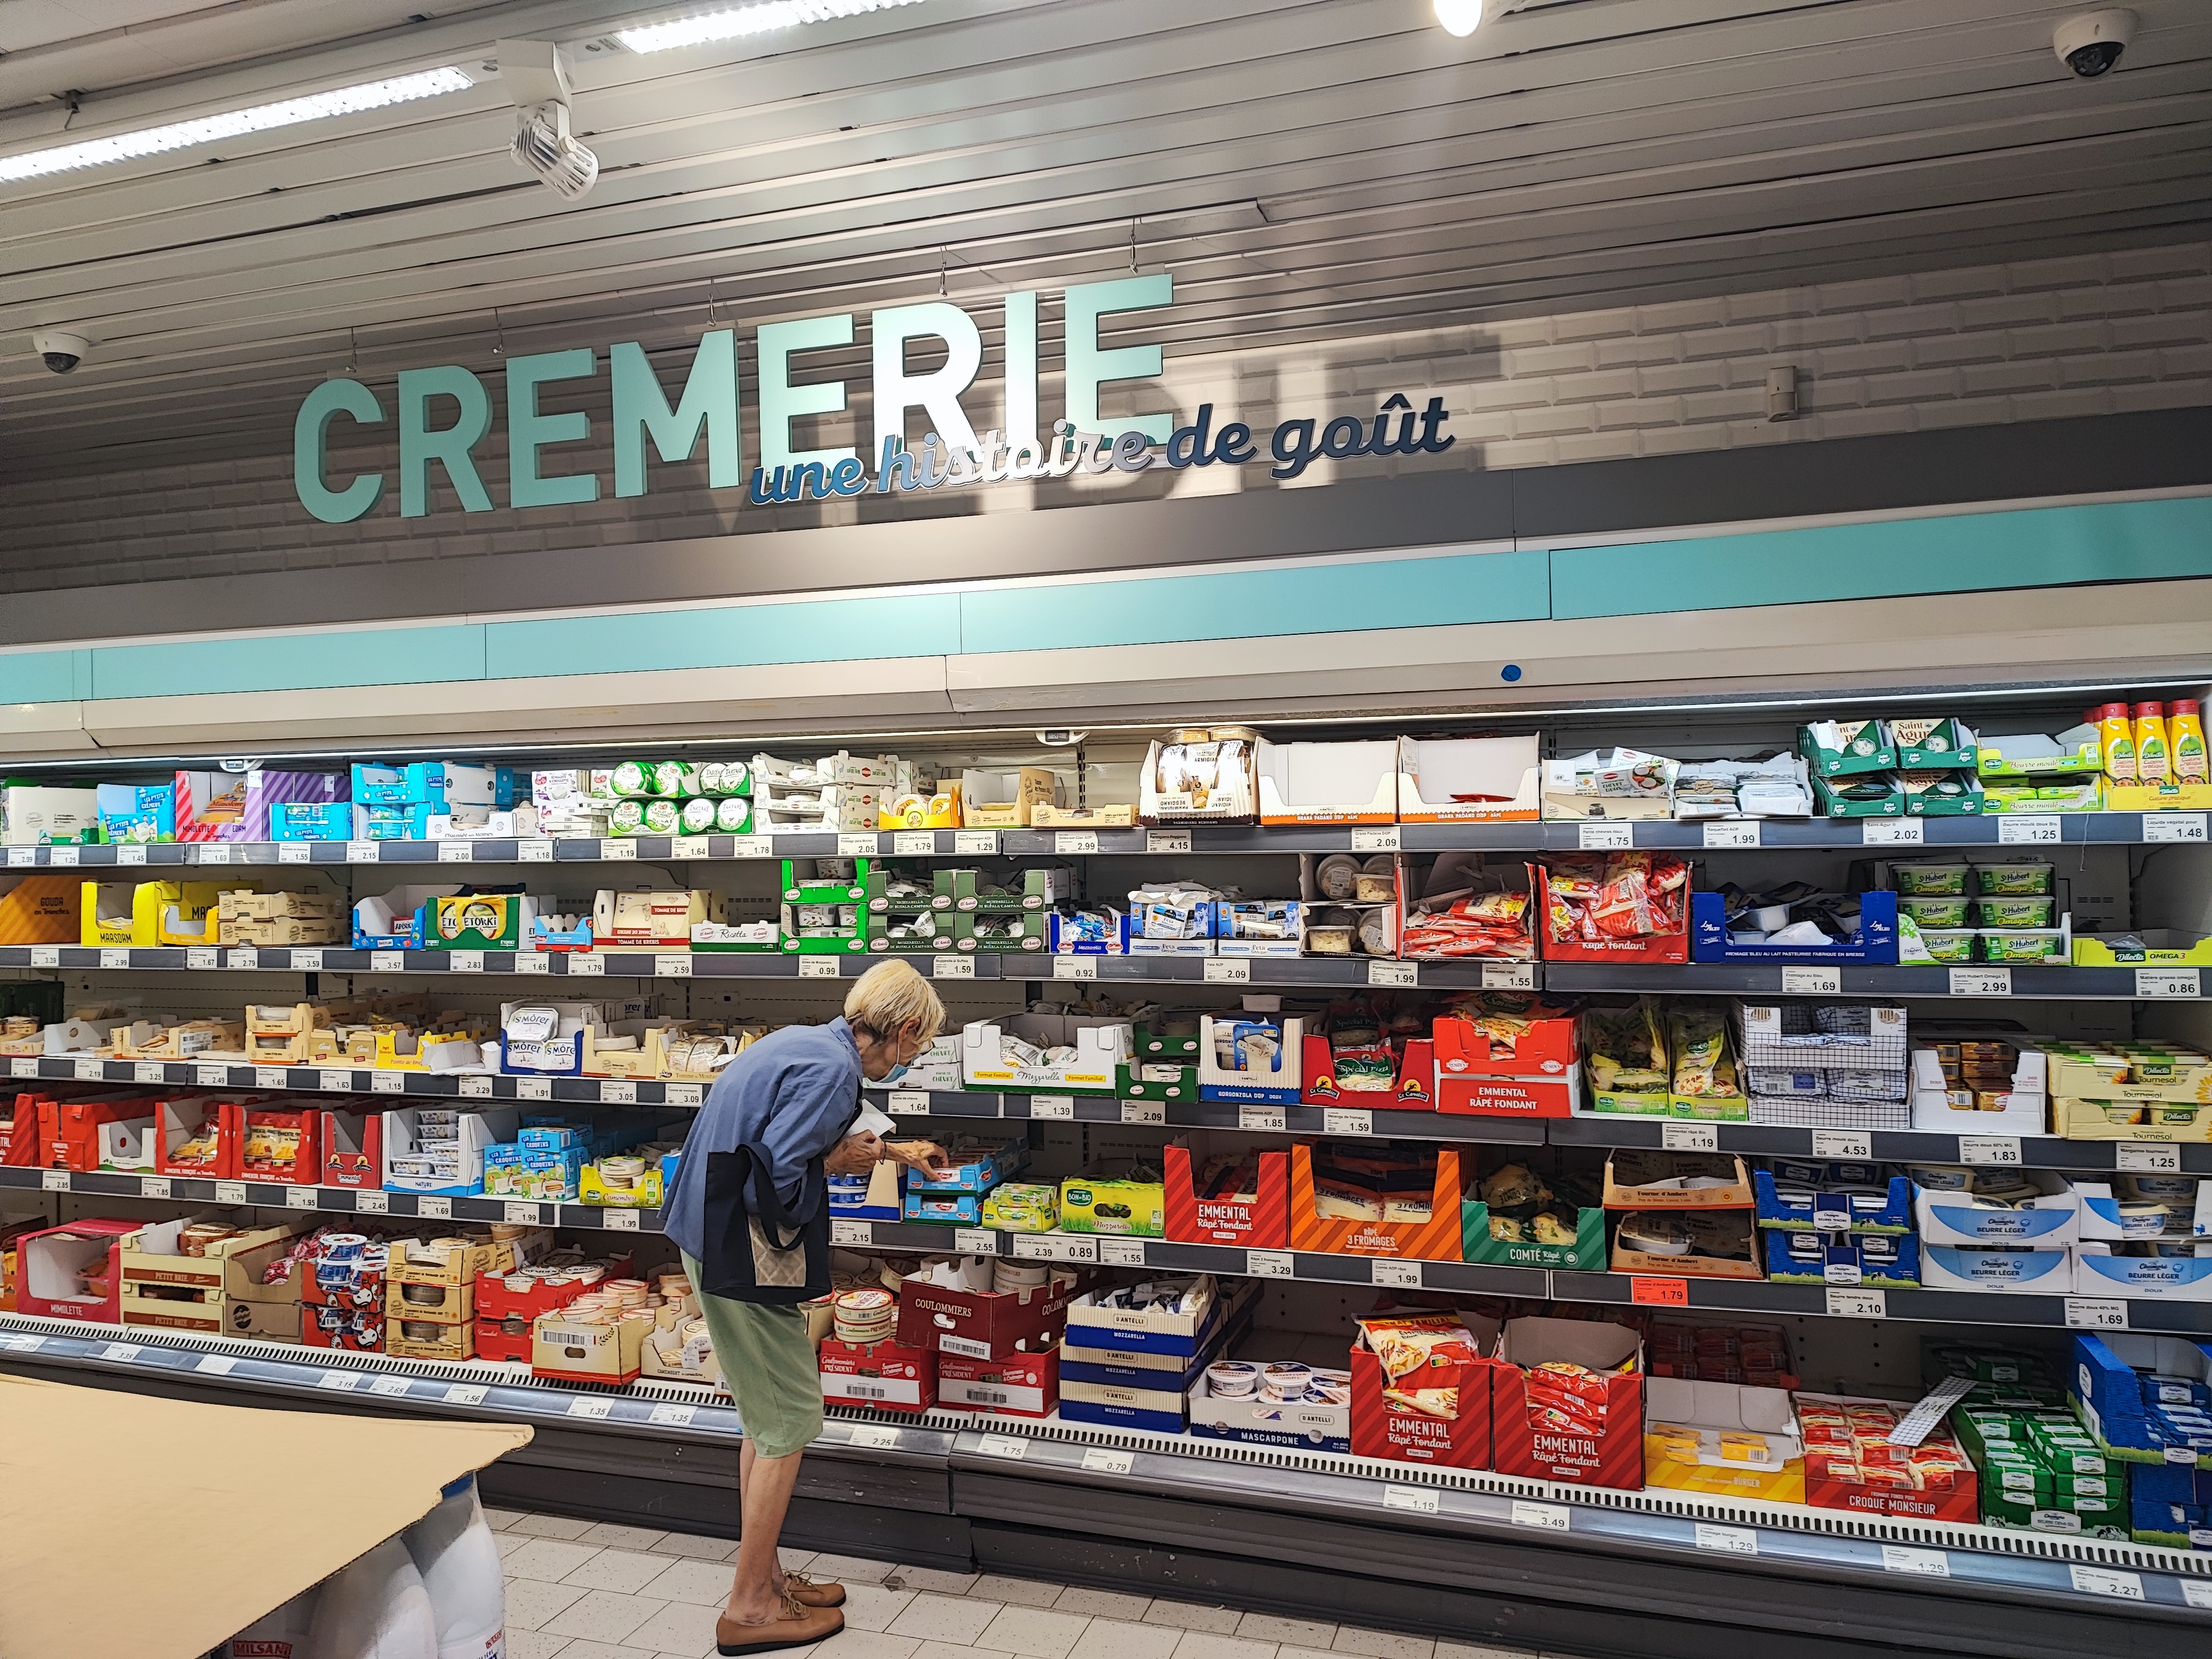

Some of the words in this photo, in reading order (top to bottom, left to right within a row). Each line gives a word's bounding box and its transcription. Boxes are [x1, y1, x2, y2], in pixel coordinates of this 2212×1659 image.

[294, 274, 1174, 524] CREMERIE
[749, 452, 870, 507] une
[878, 420, 1155, 492] histoire
[1164, 405, 1255, 469] de
[1269, 392, 1456, 479] goût
[1898, 722, 1923, 730] Saint
[1896, 731, 1931, 745] Agur
[2010, 760, 2036, 769] Beurre
[2038, 759, 2058, 768] moulé
[2010, 801, 2036, 810] Beurre
[1894, 831, 1918, 839] 2.02
[2032, 831, 2056, 839] 1.25
[2177, 829, 2201, 837] 1.48
[1377, 839, 1396, 847] 2.09
[1733, 835, 1755, 843] 1.99
[41, 897, 63, 906] GOUDA
[101, 933, 132, 943] MAASDAM
[720, 928, 748, 939] Ricotta
[2017, 939, 2038, 948] Hubert
[2004, 951, 2036, 960] Oméga
[2037, 951, 2043, 959] 3
[2116, 952, 2145, 962] Dilecta
[1813, 982, 1835, 990] 1.69
[1983, 983, 2006, 991] 2.99
[2169, 984, 2195, 993] 0.86
[1340, 1065, 1366, 1074] Spécial
[1369, 1064, 1389, 1072] Pizza
[1018, 1071, 1060, 1084] Mozzarella
[1479, 1088, 1527, 1097] EMMENTAL
[1470, 1097, 1493, 1107] RÂPÉ
[1495, 1100, 1537, 1109] FONDANT
[1350, 1123, 1369, 1131] 1.59
[1691, 1138, 1713, 1147] 1.19
[1843, 1146, 1866, 1155] 4.53
[1991, 1151, 2016, 1161] 1.83
[2150, 1158, 2174, 1167] 1.25
[603, 1193, 637, 1202] Camembert
[1198, 1205, 1251, 1220] EMMENTAL
[1092, 1221, 1131, 1230] Mozzarella
[1197, 1218, 1218, 1229] Râpé
[1219, 1219, 1253, 1230] Fondant
[1348, 1236, 1353, 1244] 3
[1354, 1235, 1395, 1247] FROMAGES
[1070, 1247, 1092, 1258] 0.89
[1510, 1248, 1541, 1260] COMTÉ
[1272, 1266, 1290, 1275] 3.29
[1398, 1275, 1417, 1284] 1.99
[1661, 1291, 1683, 1300] 1.79
[915, 1299, 972, 1316] COULOMMIERS
[1858, 1303, 1881, 1313] 2.10
[2098, 1314, 2122, 1324] 1.69
[822, 1356, 855, 1365] Coulommiers
[1389, 1418, 1449, 1437] EMMENTAL
[1241, 1432, 1298, 1445] MASCARPONE
[1387, 1433, 1411, 1445] Râpé
[1412, 1436, 1452, 1448] Fondant
[1534, 1434, 1598, 1455] EMMENTAL
[1003, 1447, 1021, 1455] 1.75
[1531, 1450, 1557, 1462] Râpé
[1558, 1454, 1600, 1467] Fondant
[1107, 1462, 1126, 1471] 0.79
[1734, 1477, 1760, 1487] BURGER
[1412, 1500, 1434, 1510] 1.19
[1849, 1495, 1885, 1509] CROQUE
[1888, 1499, 1936, 1515] MONSIEUR
[1541, 1517, 1564, 1527] 3.49
[1728, 1541, 1753, 1551] 1.29
[1918, 1563, 1945, 1573] 1.29
[2110, 1584, 2138, 1596] 2.27
